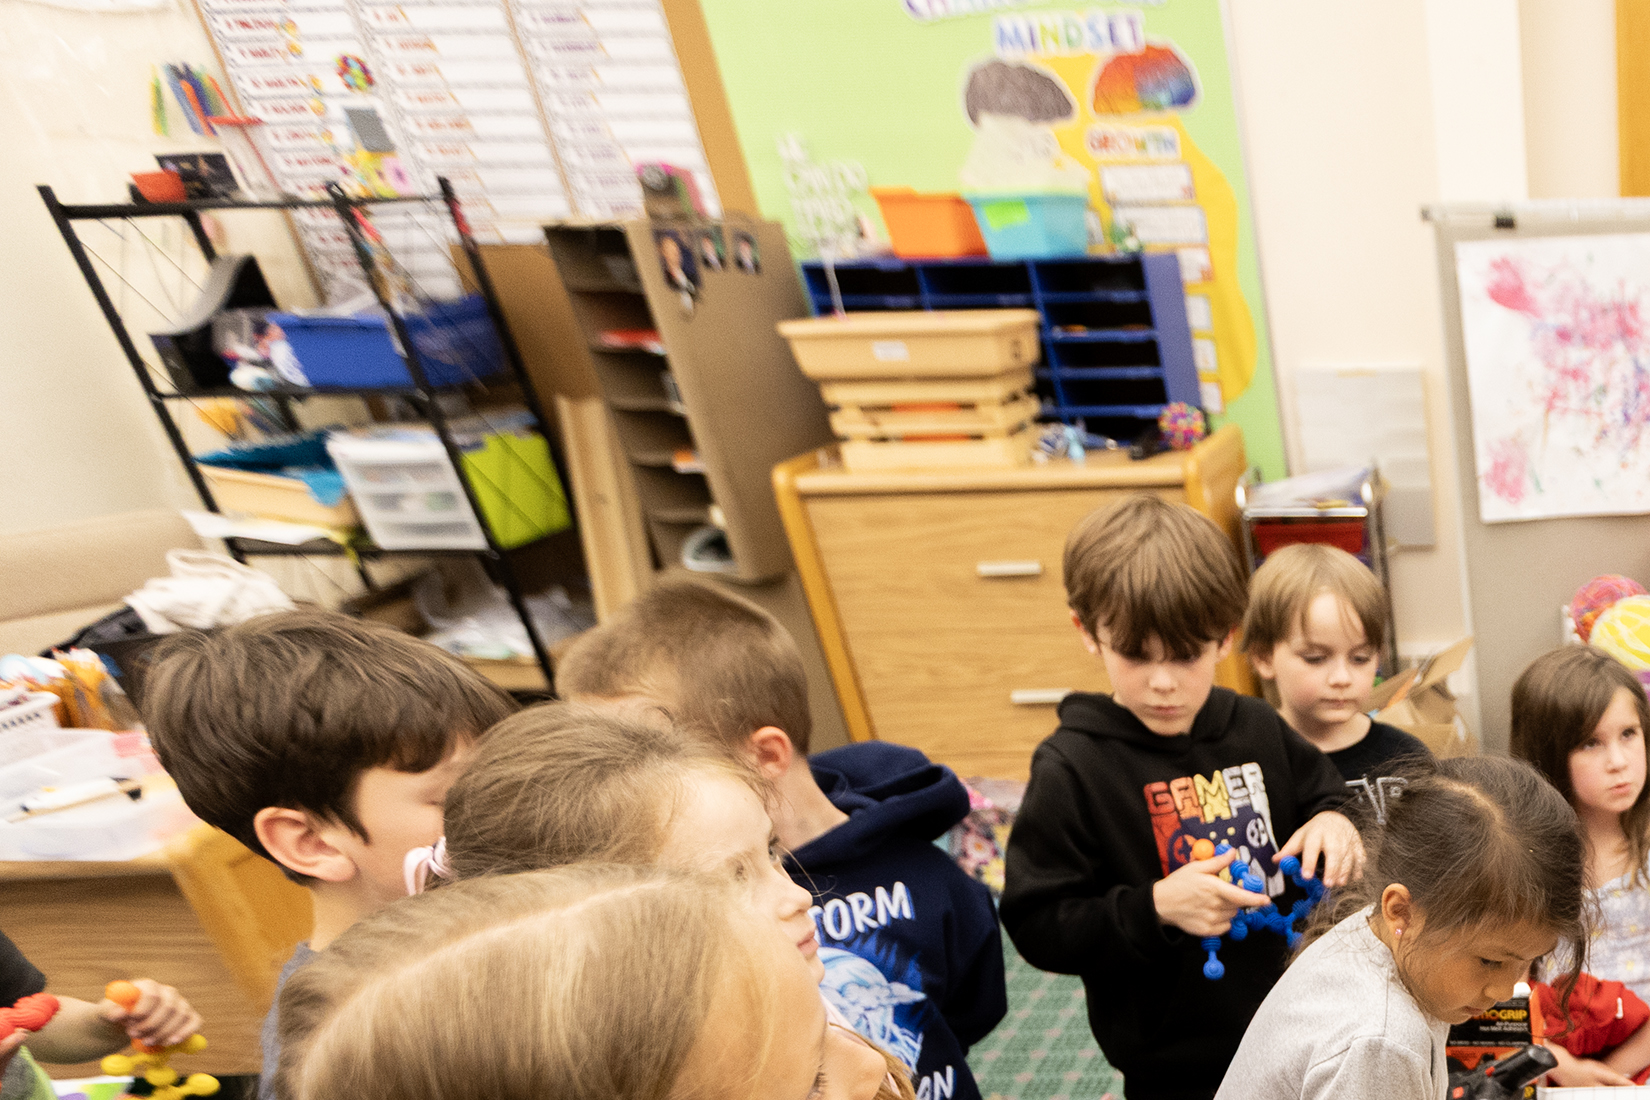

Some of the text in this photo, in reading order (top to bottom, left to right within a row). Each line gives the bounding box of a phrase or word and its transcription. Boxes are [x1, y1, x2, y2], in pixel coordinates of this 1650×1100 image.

[999, 14, 1138, 50] MINDSET
[1143, 761, 1267, 816] GAMER
[807, 881, 914, 947] TORM
